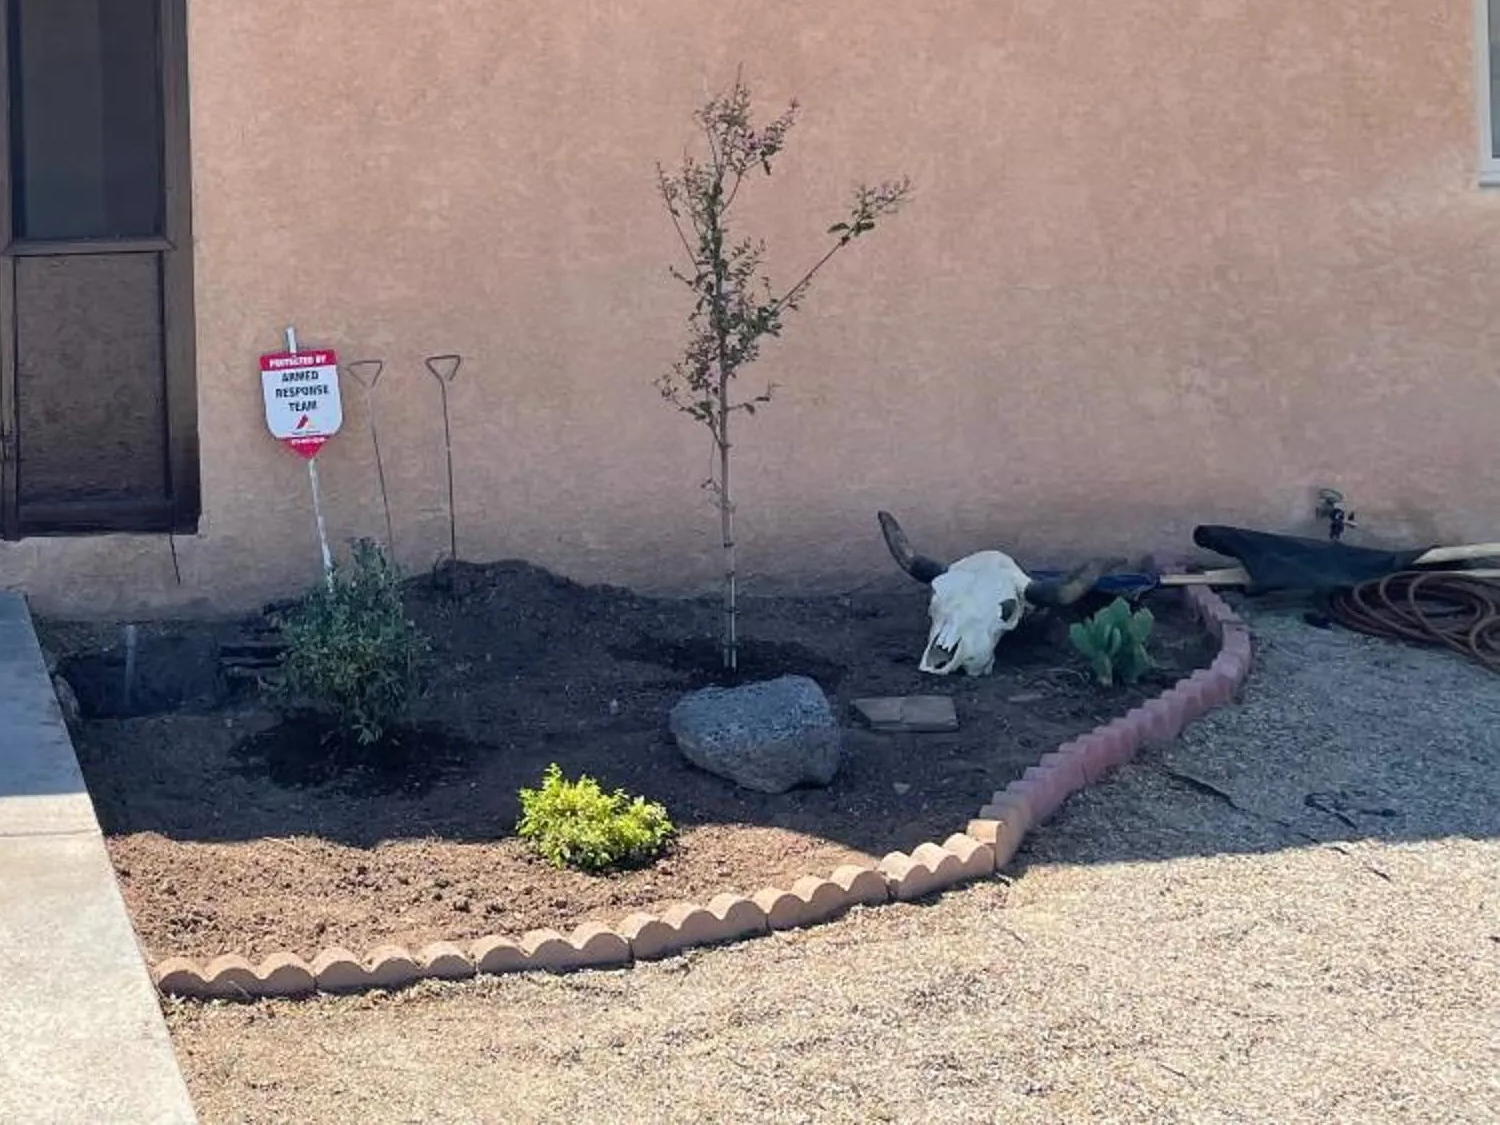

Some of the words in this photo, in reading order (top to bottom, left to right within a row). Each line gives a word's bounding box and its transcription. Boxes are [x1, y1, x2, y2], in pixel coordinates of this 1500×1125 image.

[281, 370, 319, 382] ARMED
[275, 384, 329, 398] RESPONSE
[287, 400, 317, 412] TEAM
